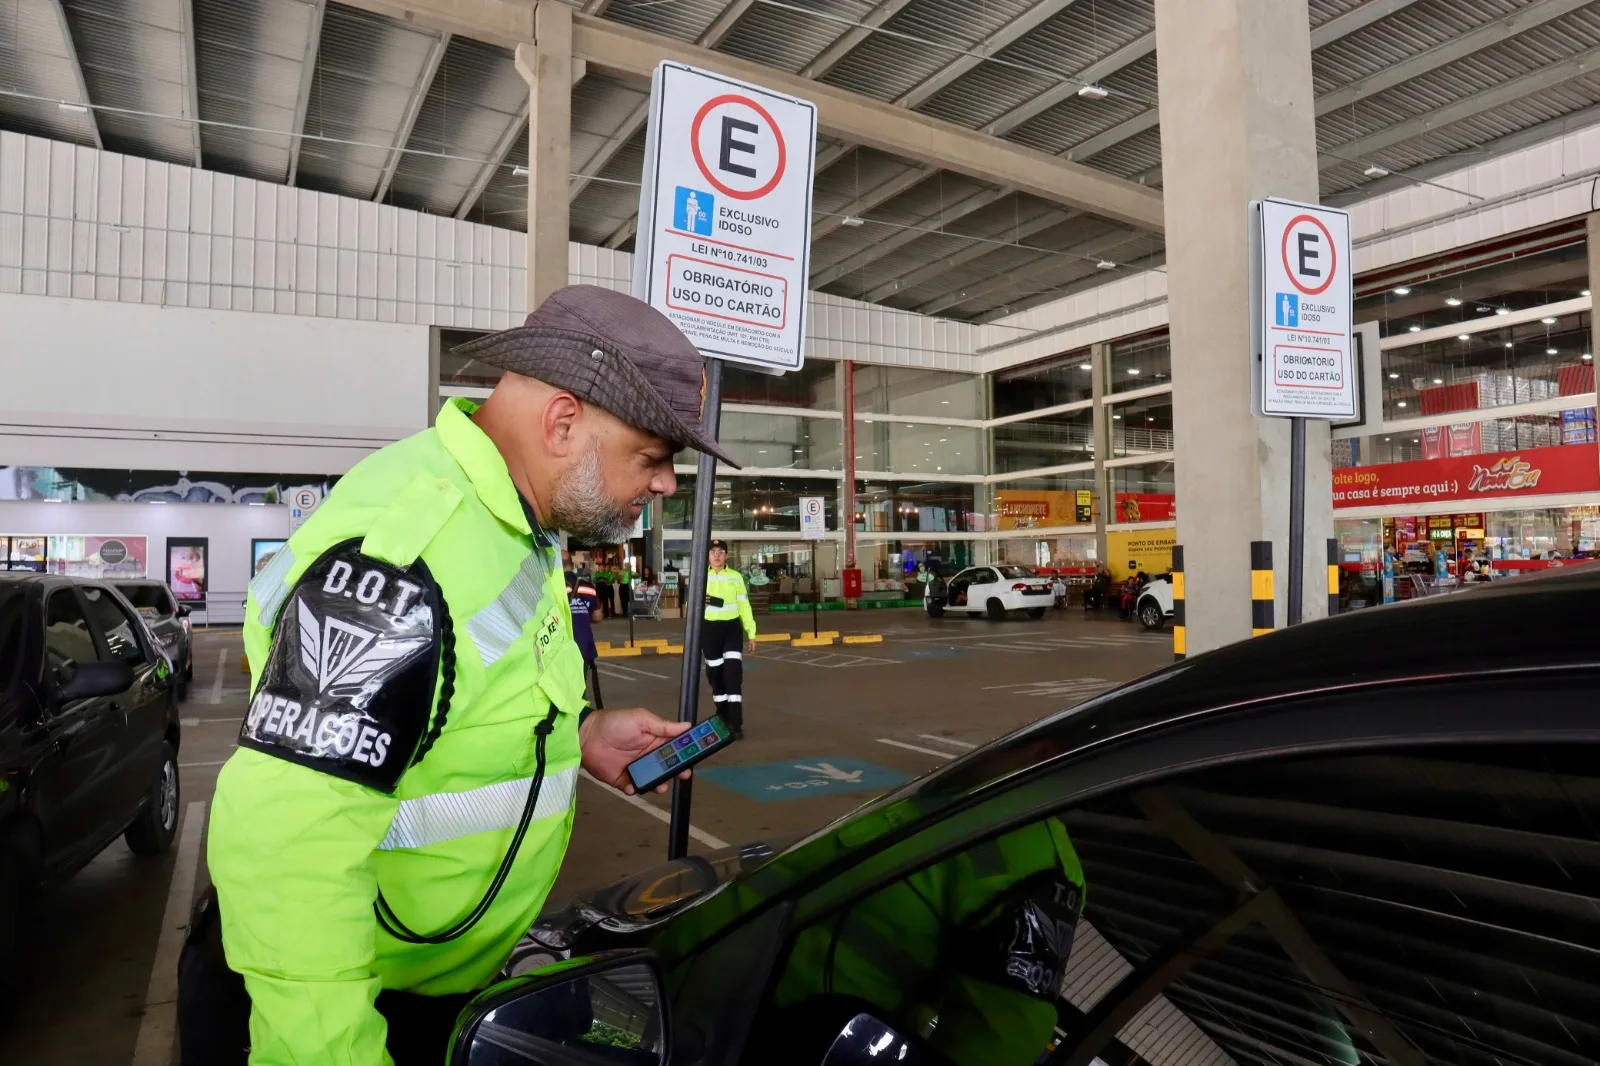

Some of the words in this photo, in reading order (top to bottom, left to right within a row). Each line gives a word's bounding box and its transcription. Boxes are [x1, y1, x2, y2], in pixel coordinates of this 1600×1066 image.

[719, 115, 759, 179] E
[719, 207, 780, 229] EXCLUSIVO
[718, 220, 752, 236] IDOSO
[692, 243, 708, 255] LEI
[1298, 232, 1321, 278] E
[683, 269, 773, 298] OBRIGATÓRIO
[672, 287, 701, 303] USO
[705, 294, 724, 308] DO
[727, 299, 781, 319] CARTÃO
[1301, 303, 1336, 314] EXCLUSIVO
[1301, 313, 1321, 322] IDOSO
[1287, 334, 1296, 342] LEI
[1283, 354, 1335, 367] OBRIGATÓRIO
[1278, 369, 1294, 379] USO
[1296, 371, 1307, 380] DO
[1309, 371, 1341, 382] CARTÃO
[1355, 472, 1379, 485] logo,
[1332, 491, 1345, 501] ua
[1347, 489, 1370, 500] casa
[1372, 486, 1379, 498] é
[1380, 484, 1420, 498] sempre
[1423, 480, 1449, 496] aqui
[301, 494, 310, 505] E
[810, 503, 816, 512] E
